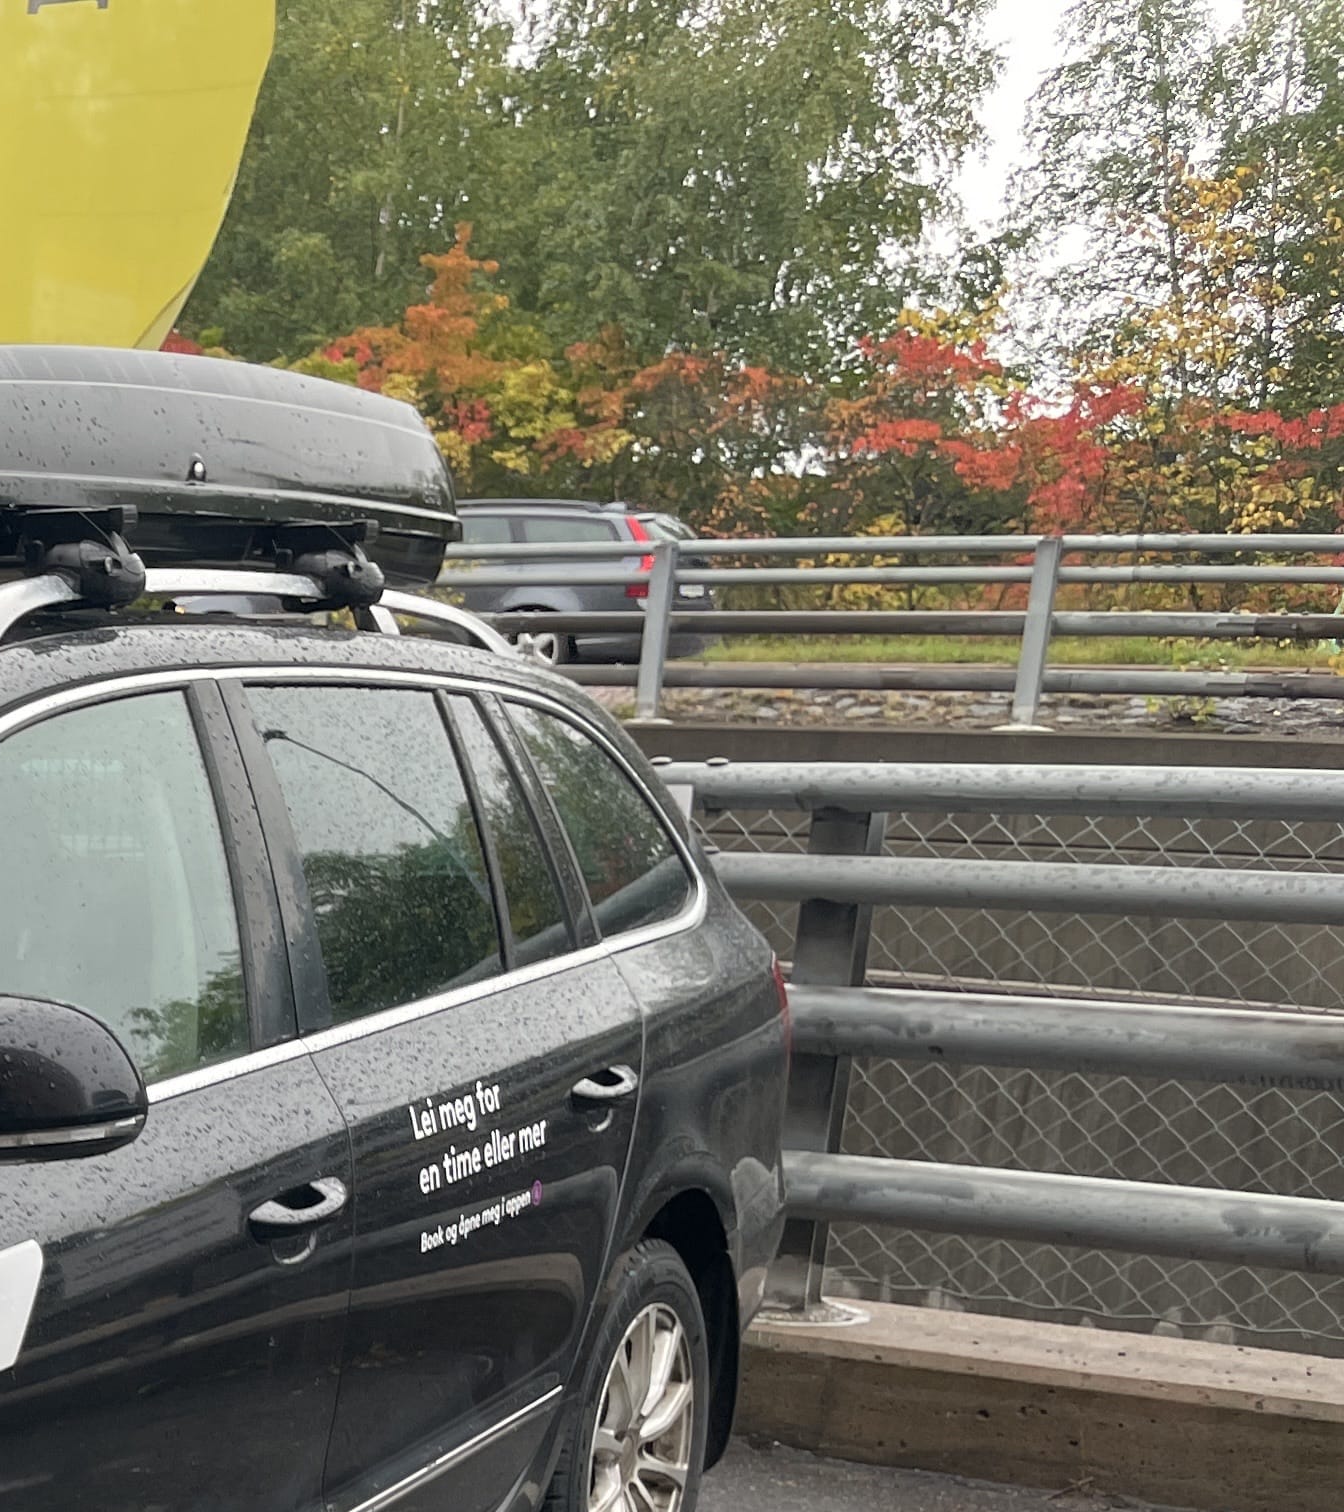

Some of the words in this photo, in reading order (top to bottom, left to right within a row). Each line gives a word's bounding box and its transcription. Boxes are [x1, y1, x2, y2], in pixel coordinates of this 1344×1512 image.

[409, 1097, 438, 1140] Lei
[438, 1094, 477, 1132] meg
[475, 1080, 501, 1115] for
[419, 1163, 441, 1194] en
[442, 1145, 481, 1184] time
[483, 1129, 516, 1168] eller
[518, 1119, 548, 1154] mer
[420, 1225, 444, 1253] Book
[445, 1222, 458, 1245] og
[458, 1214, 480, 1239] åpne
[481, 1203, 501, 1225] meg
[500, 1196, 506, 1217] i
[505, 1190, 532, 1218] appen
